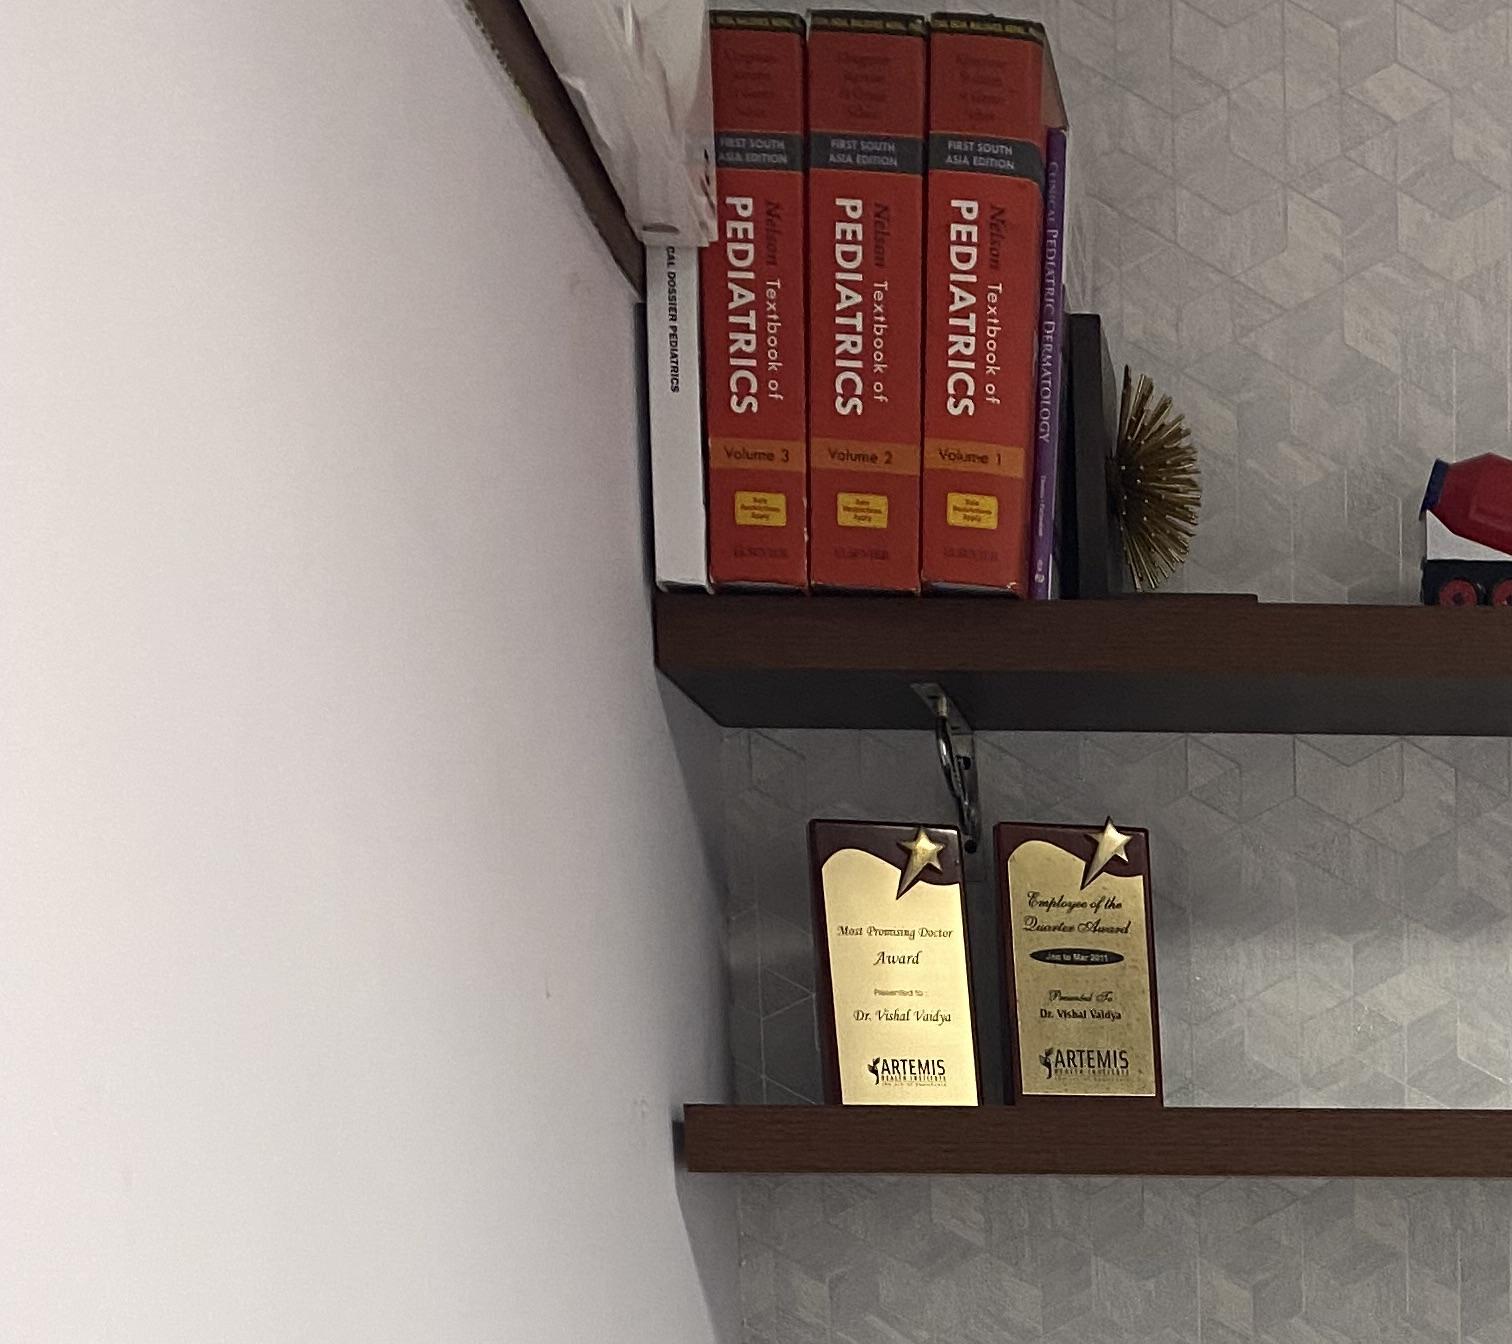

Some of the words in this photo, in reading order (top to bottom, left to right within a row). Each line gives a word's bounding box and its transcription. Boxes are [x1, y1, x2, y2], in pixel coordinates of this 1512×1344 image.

[831, 139, 857, 149] FIRST
[860, 140, 896, 152] SOUTH
[948, 141, 974, 153] FIRST
[978, 143, 1013, 156] SOUTH
[829, 153, 853, 164] ASIA
[856, 154, 897, 167] EDITION
[946, 154, 970, 165] ASIA
[973, 157, 1014, 170] EDITION
[1043, 229, 1059, 315] PEDIATRIC
[667, 272, 678, 322] DOSSIER
[725, 197, 758, 414] PEDIATRICS
[835, 198, 863, 416] PEDIATRICS
[947, 200, 979, 416] PEDIATRICS
[766, 279, 783, 371] Textbook
[873, 281, 888, 374] Textbook
[985, 283, 1002, 375] Textbook
[668, 325, 680, 394] PEDIATRICS
[768, 380, 784, 400] of
[1038, 320, 1056, 444] DERMATOLOGY
[873, 382, 888, 403] of
[985, 383, 1000, 405] of
[724, 447, 775, 463] Volume
[782, 449, 790, 463] 3
[828, 448, 879, 464] Volume
[884, 451, 893, 464] 2
[939, 448, 989, 464] Volume
[1027, 891, 1087, 912] Employee
[1089, 895, 1105, 913] of
[1104, 896, 1122, 910] the
[837, 925, 863, 936] Most
[866, 926, 916, 941] Promising
[918, 927, 954, 939] Doctor
[1023, 915, 1075, 934] Quarter
[1077, 919, 1131, 934] Award
[873, 950, 923, 966] Award
[853, 1009, 872, 1022] Dr.
[875, 1008, 911, 1022] Vishal
[913, 1009, 951, 1026] Vaidya
[1040, 1009, 1053, 1019] Dr.
[1057, 1009, 1087, 1020] Vishal
[1091, 1009, 1121, 1022] Vaidya
[881, 1059, 946, 1076] ARTEMIS
[1055, 1050, 1129, 1069] ARTEMIS
